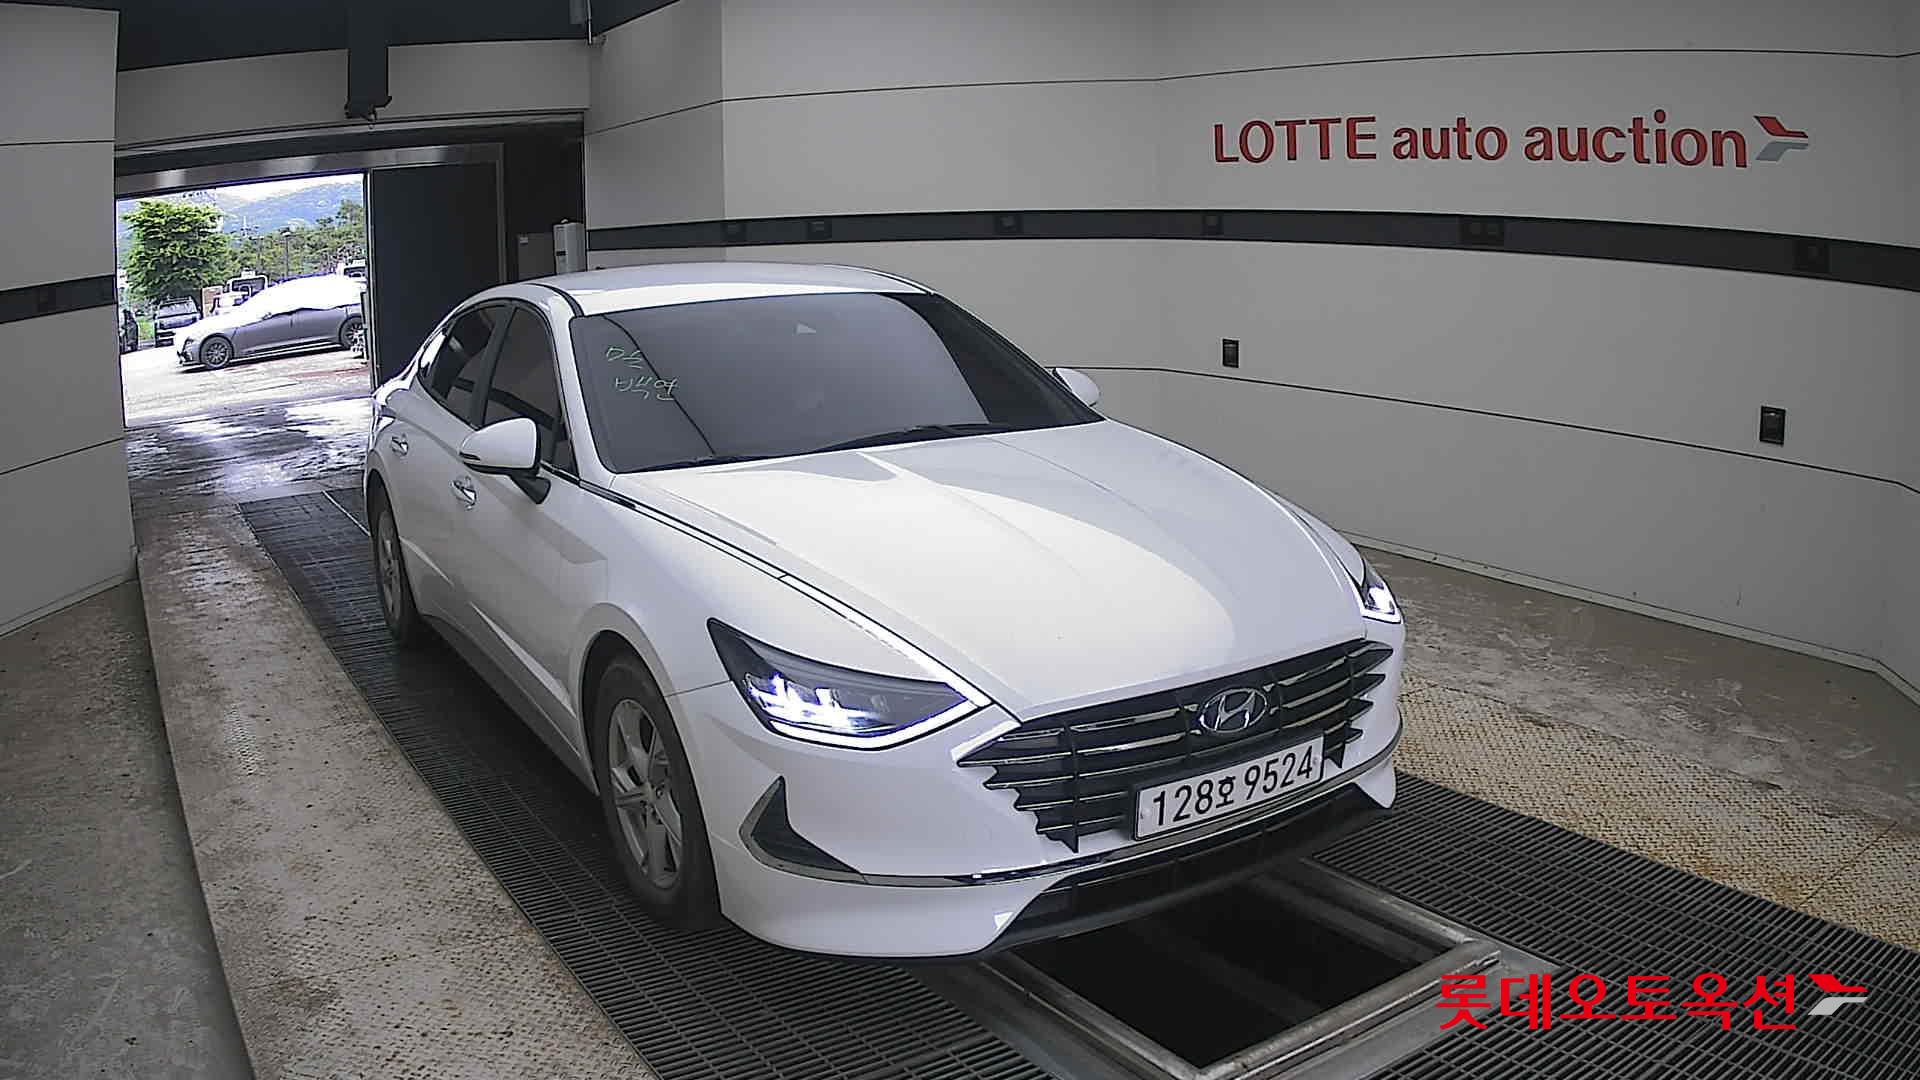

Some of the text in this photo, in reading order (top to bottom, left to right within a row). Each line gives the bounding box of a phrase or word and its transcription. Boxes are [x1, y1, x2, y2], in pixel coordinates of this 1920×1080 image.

[1214, 109, 1748, 168] LOTTE auto auction
[1153, 745, 1313, 826] 128호 9524
